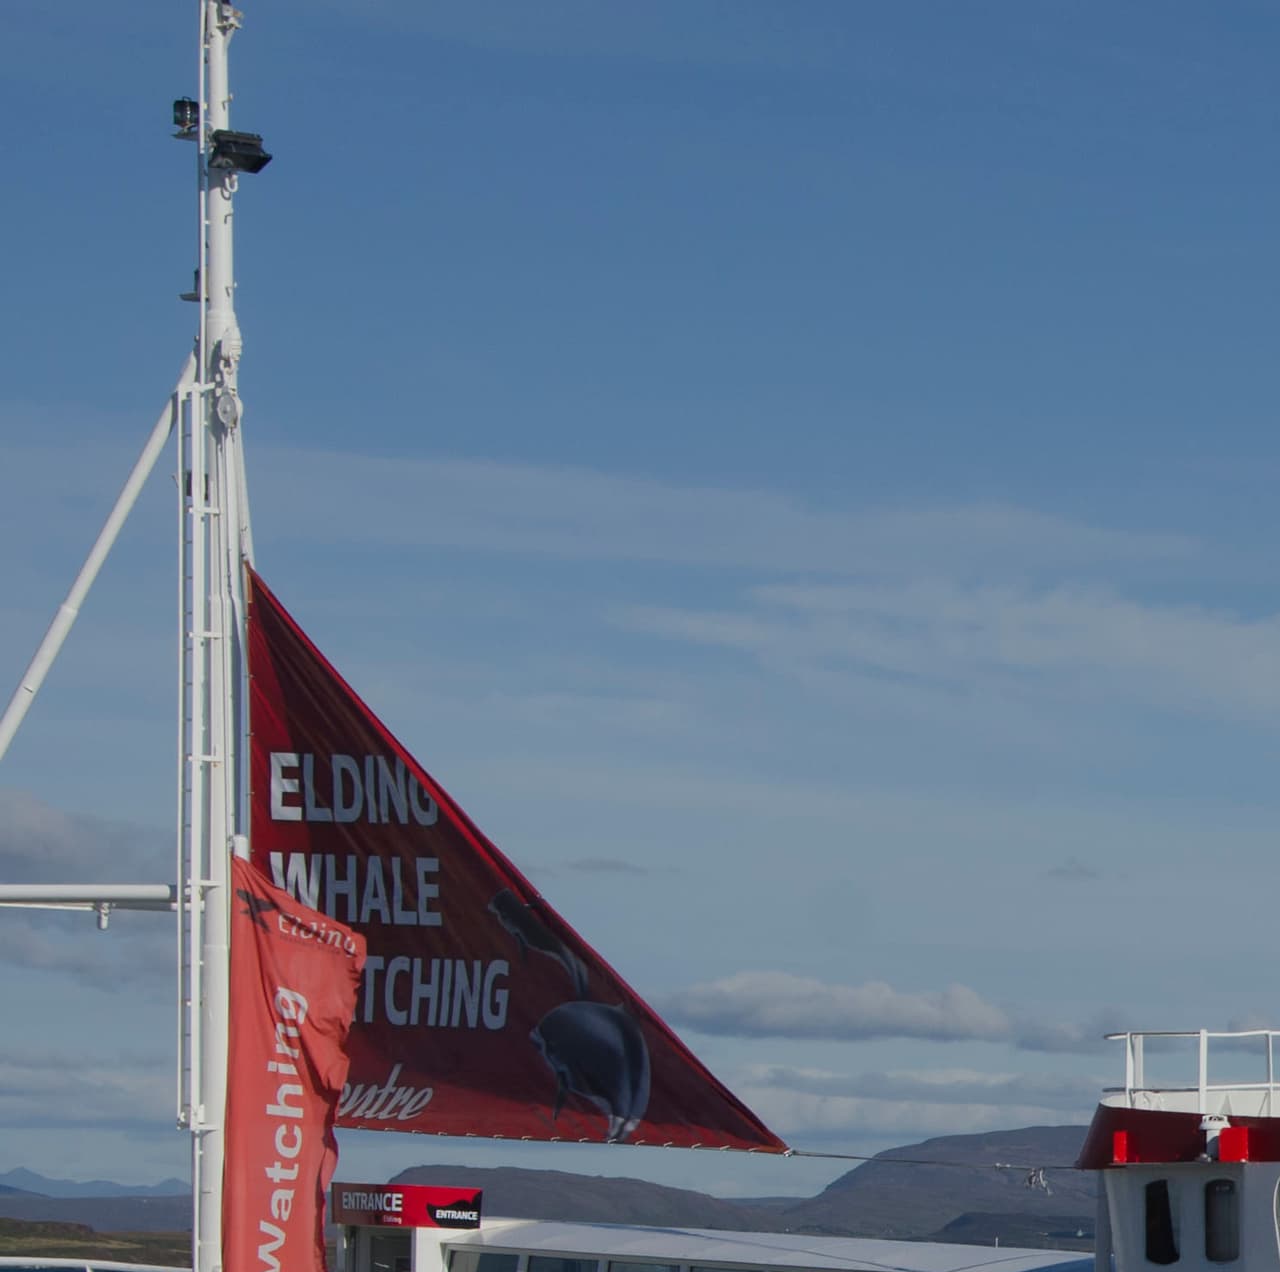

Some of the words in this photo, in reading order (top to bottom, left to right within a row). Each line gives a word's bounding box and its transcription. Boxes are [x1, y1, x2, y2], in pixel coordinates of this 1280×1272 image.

[270, 751, 439, 827] ELDING
[269, 851, 443, 927] WHALE
[278, 912, 357, 958] Elding
[352, 956, 510, 1030] TCHING
[338, 1063, 434, 1121] ntre
[342, 1192, 403, 1212] ENTRANCE
[435, 1209, 478, 1220] ENTRANCE
